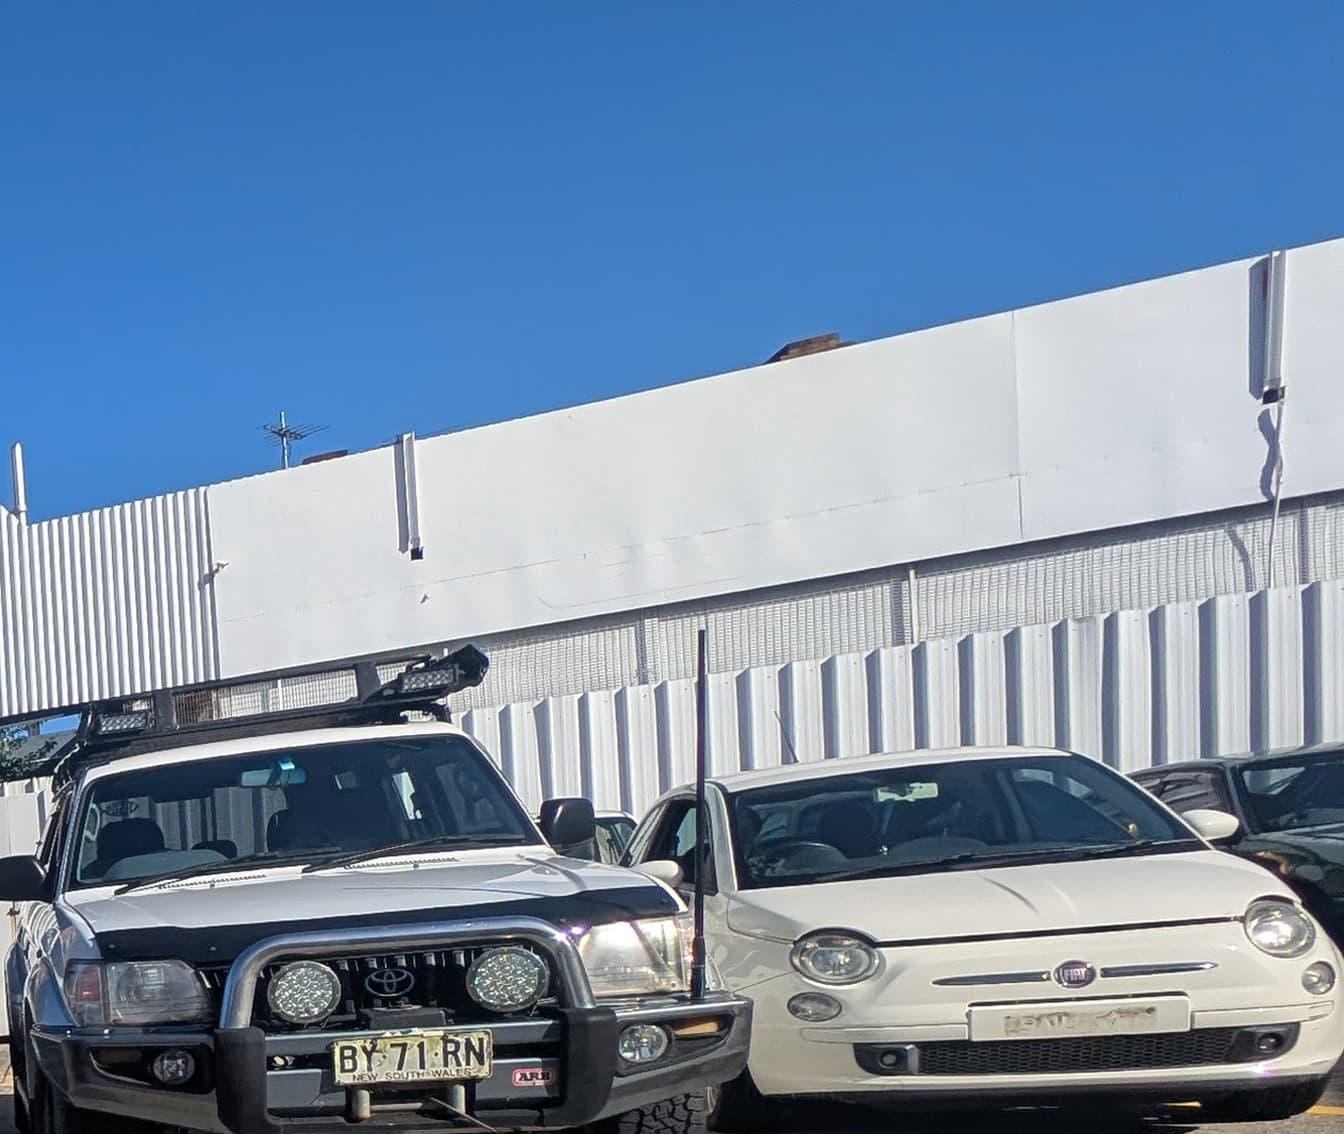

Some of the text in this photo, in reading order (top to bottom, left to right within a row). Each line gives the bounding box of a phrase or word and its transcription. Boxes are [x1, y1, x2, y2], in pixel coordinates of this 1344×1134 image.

[352, 1068, 472, 1082] NEW SOUTH WALES
[517, 1071, 551, 1082] ARB
